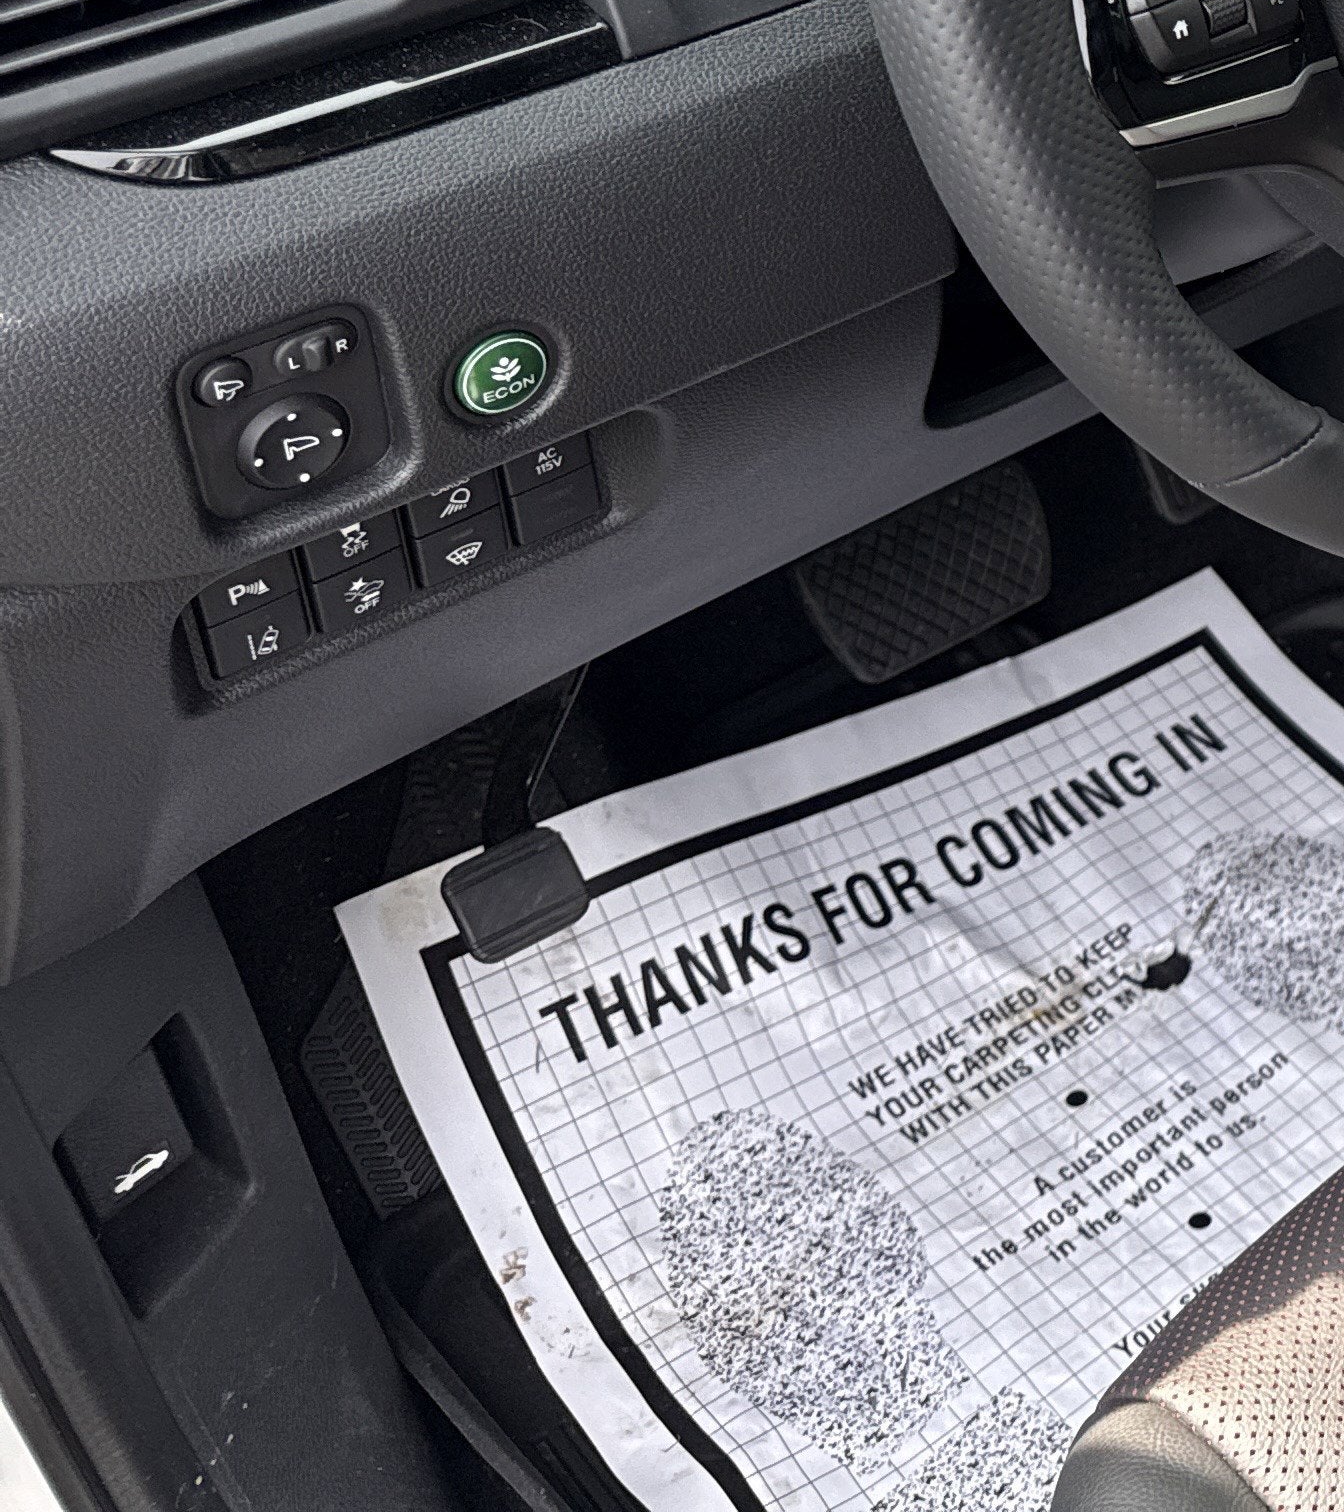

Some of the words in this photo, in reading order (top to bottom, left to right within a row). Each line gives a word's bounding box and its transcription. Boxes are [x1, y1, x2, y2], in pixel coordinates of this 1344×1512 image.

[288, 357, 300, 370] L
[335, 338, 349, 354] R
[482, 374, 537, 405] ECON
[535, 456, 564, 476] 115V
[537, 447, 558, 464] AC
[342, 540, 370, 559] OFF
[354, 598, 381, 615] OFF
[539, 902, 812, 1064] THANKS
[811, 857, 936, 946] FOR
[936, 751, 1162, 888] COMING
[1154, 713, 1228, 774] IN
[848, 1064, 896, 1101] WE
[895, 1028, 966, 1078] HAVE
[963, 986, 1039, 1036] TRIED
[1039, 965, 1076, 996] TO
[1075, 922, 1133, 971] KEEP
[865, 1076, 943, 1129] YOUR
[944, 995, 1083, 1086] CARPETING
[899, 1096, 972, 1146] WITH
[971, 1056, 1034, 1102] THIS
[1034, 1004, 1114, 1066] PAPER
[972, 1237, 1020, 1273] the
[1023, 1190, 1090, 1240] most
[1087, 1104, 1209, 1197] important
[1208, 1050, 1290, 1116] person
[1032, 1175, 1055, 1197] A
[1058, 1098, 1169, 1182] customer
[1168, 1077, 1198, 1102] is
[1044, 1237, 1077, 1263] in
[1076, 1207, 1123, 1243] the
[1124, 1151, 1196, 1209] world
[1194, 1134, 1224, 1158] to
[1225, 1111, 1268, 1138] us.
